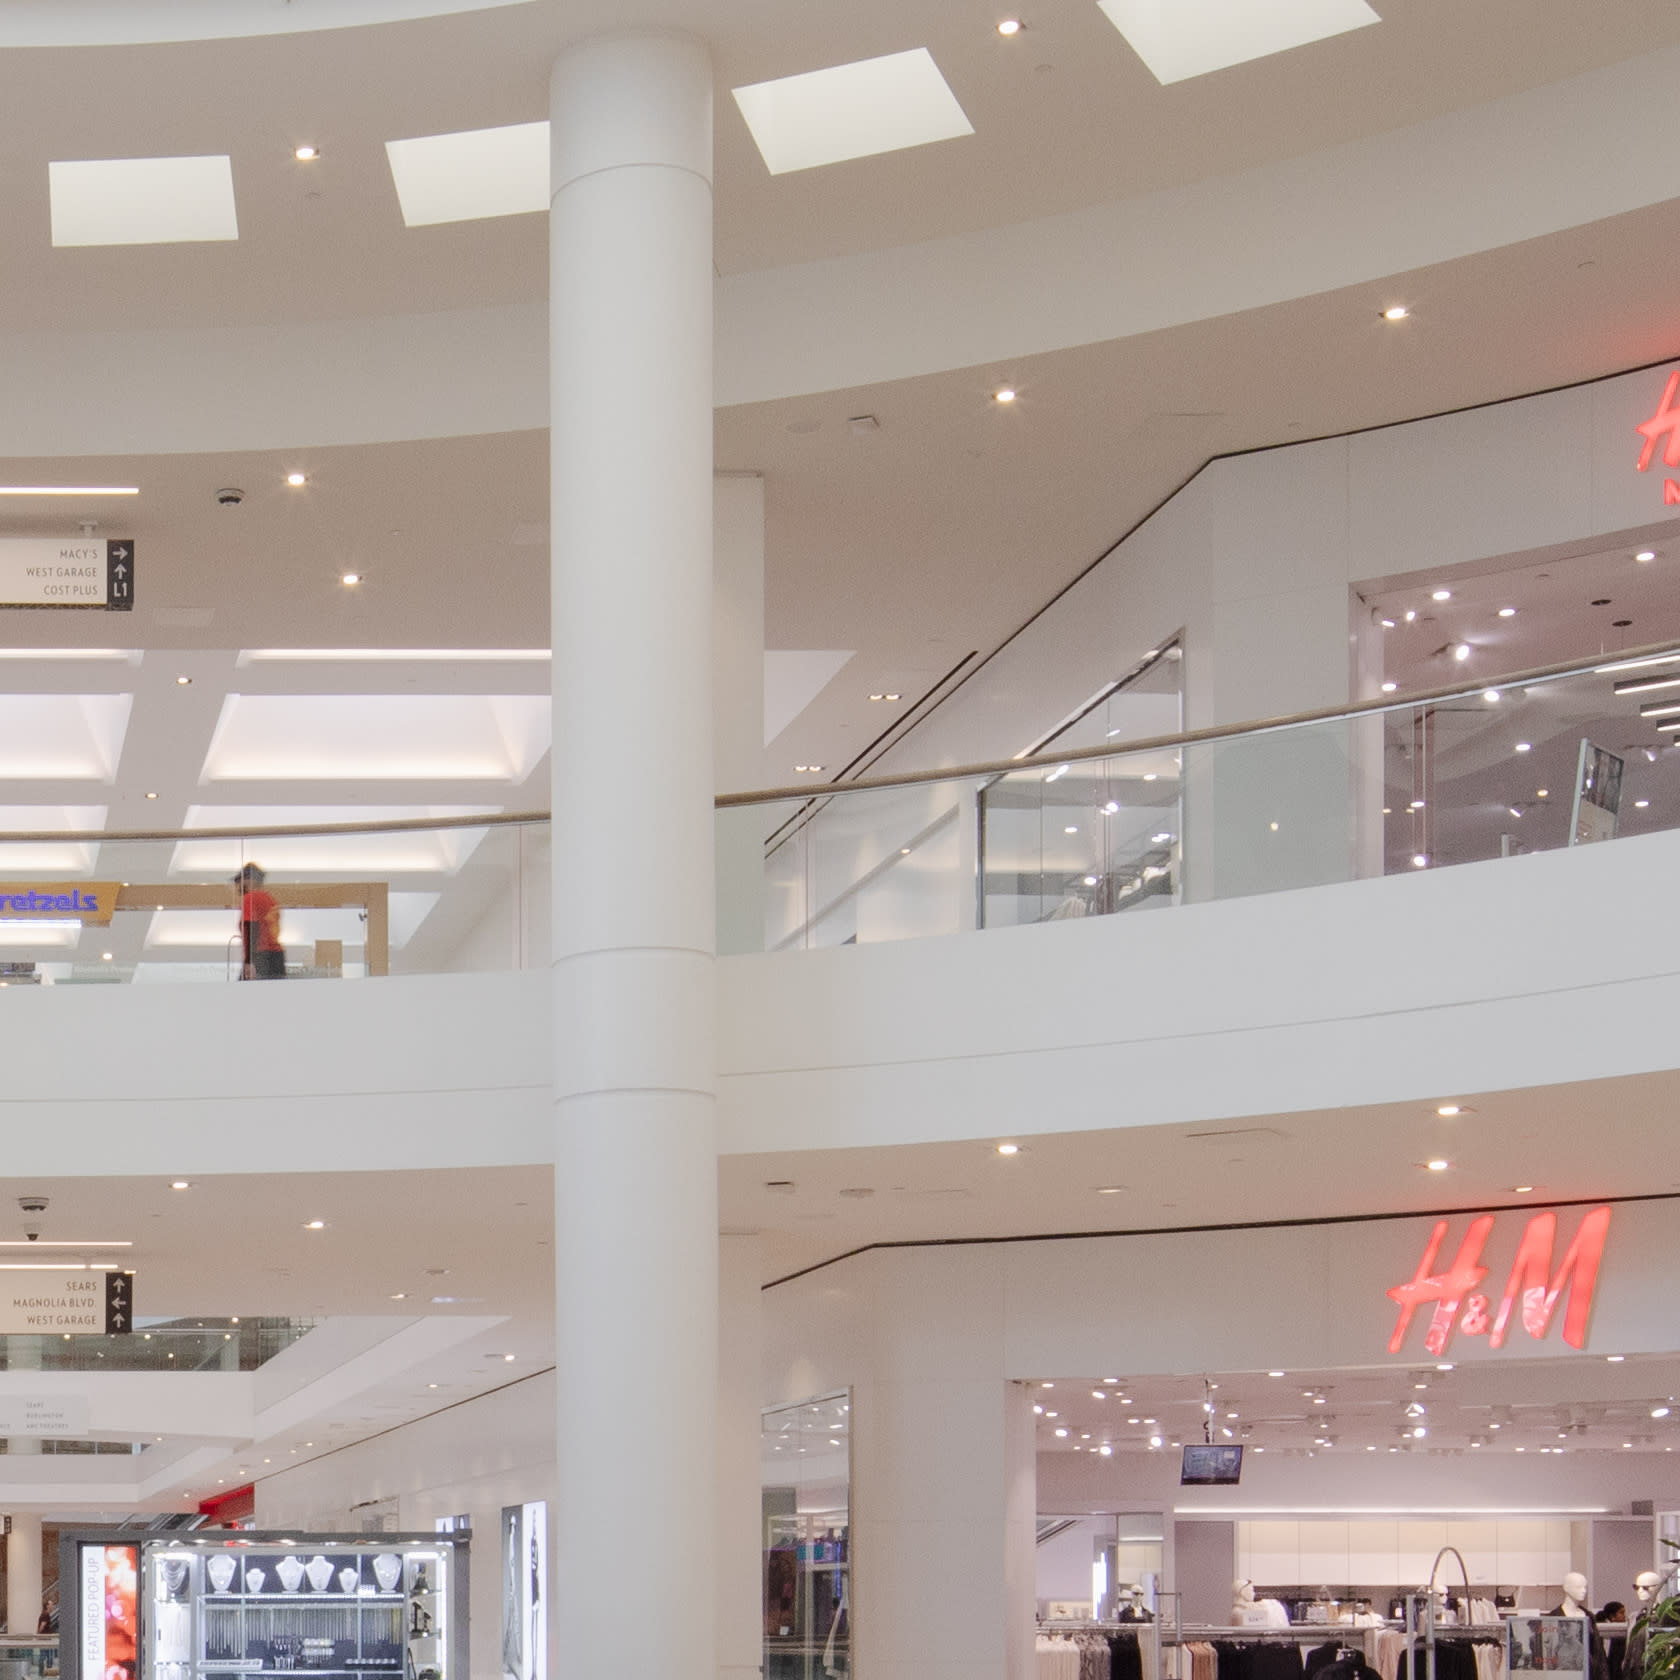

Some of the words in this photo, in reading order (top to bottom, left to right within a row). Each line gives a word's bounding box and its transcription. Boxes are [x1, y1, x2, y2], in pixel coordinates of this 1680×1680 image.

[59, 549, 98, 560] MACY'S
[26, 568, 53, 578] WEST
[56, 568, 98, 578] GARAGE
[43, 585, 71, 596] COST
[73, 585, 98, 596] PLUS
[113, 582, 128, 597] L1
[1386, 1204, 1611, 1357] H&M
[66, 1282, 97, 1292] SEARS
[13, 1298, 67, 1308] MAGNOLIA
[69, 1298, 97, 1308] BLVD.
[27, 1315, 54, 1325] WEST
[56, 1315, 97, 1325] GARAGE
[88, 1603, 101, 1661] FEATURED
